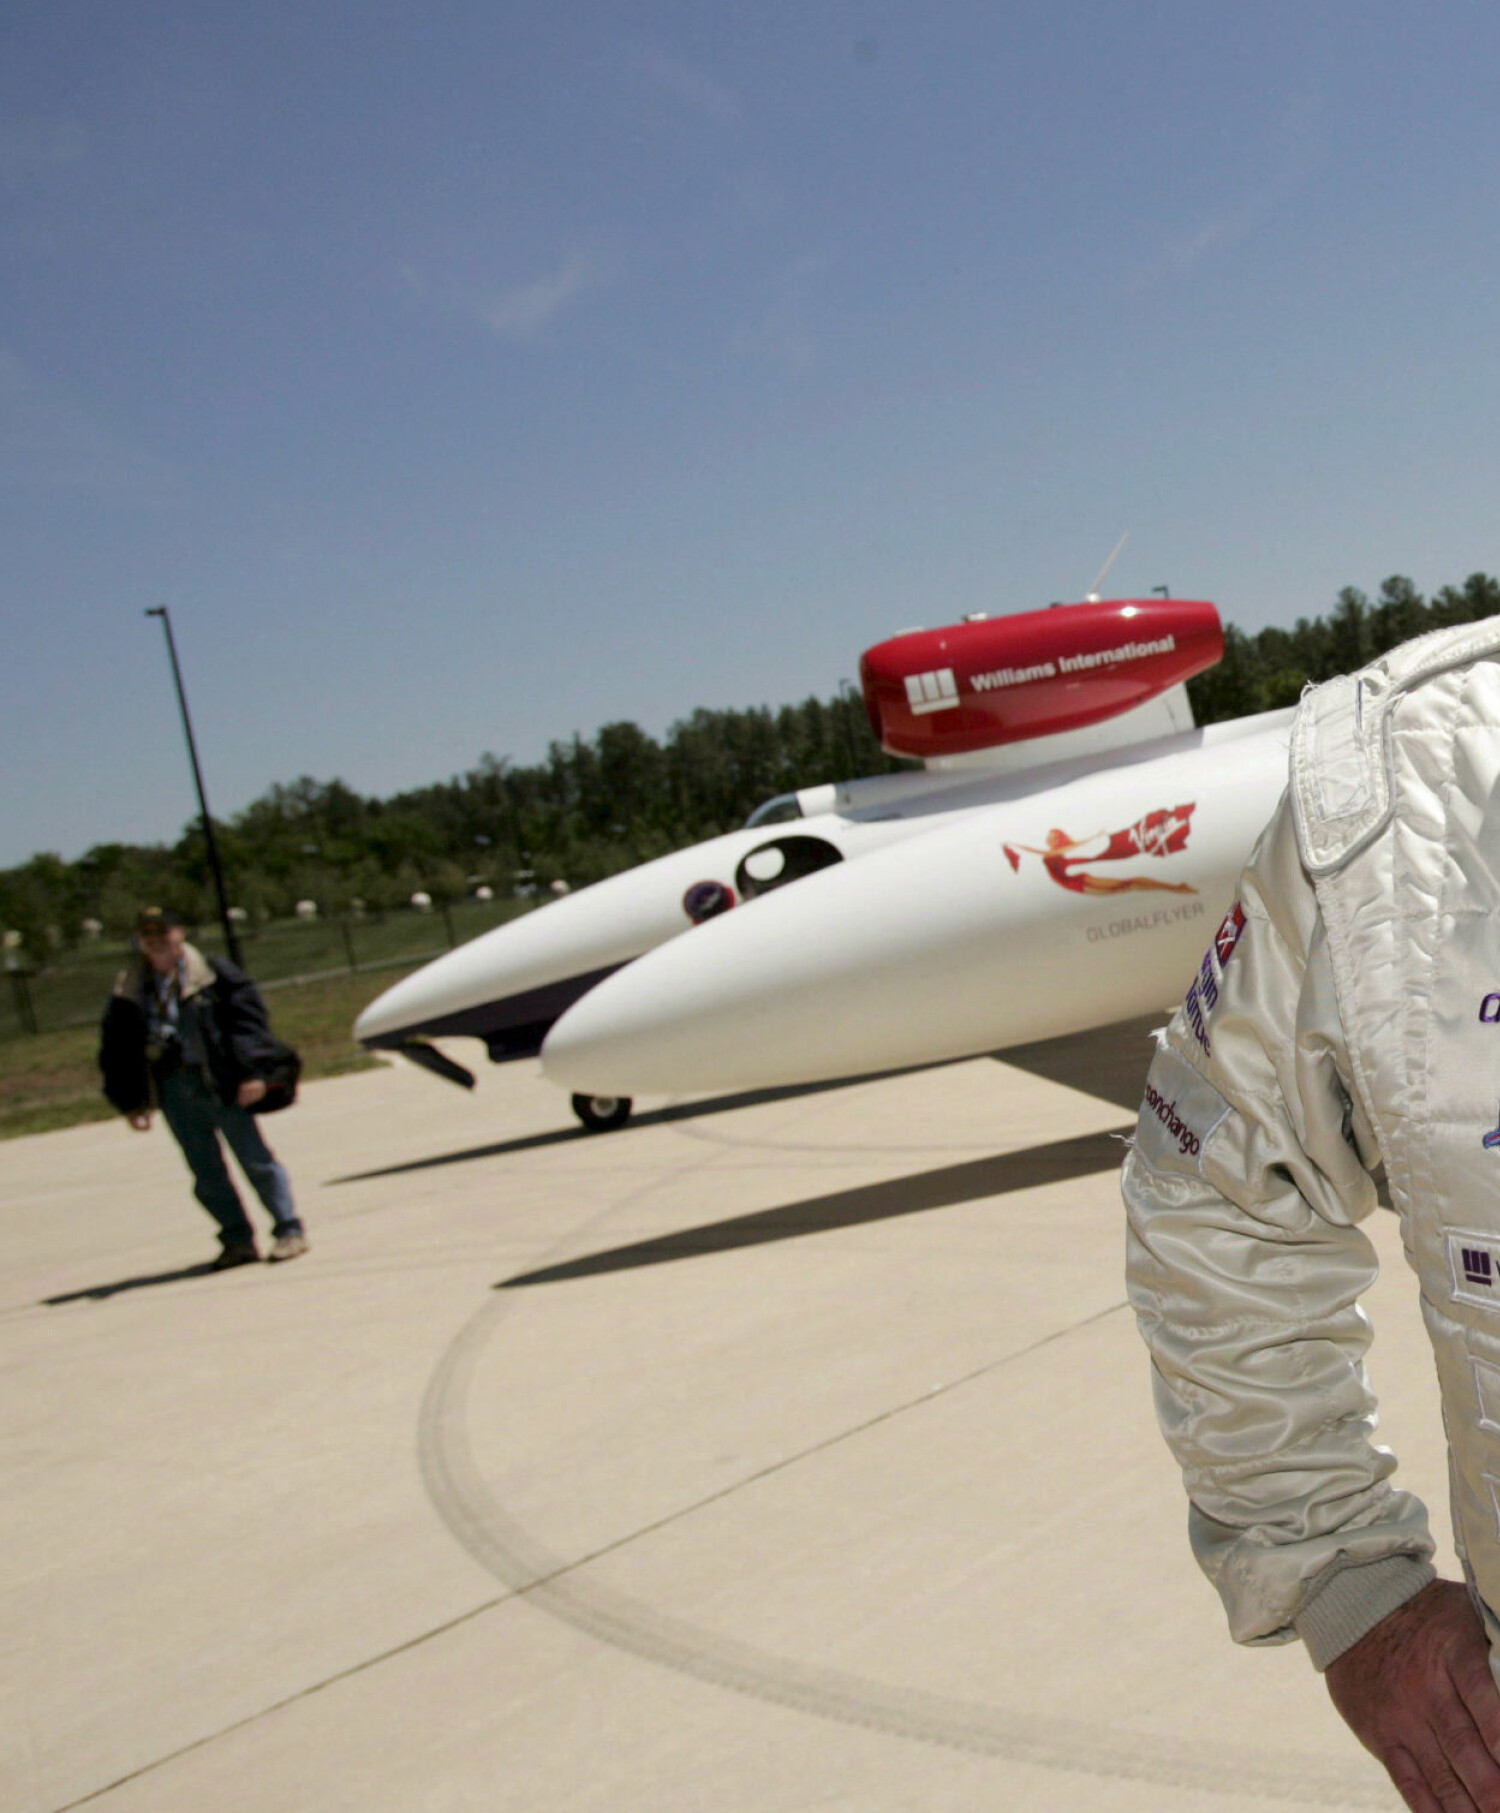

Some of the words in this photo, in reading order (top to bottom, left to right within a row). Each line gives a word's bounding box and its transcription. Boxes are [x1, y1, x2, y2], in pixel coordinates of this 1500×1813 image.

[970, 660, 1056, 692] Williams
[1059, 634, 1175, 674] International
[1128, 815, 1189, 856] Virgin
[1086, 902, 1205, 942] GLOBALFLYER
